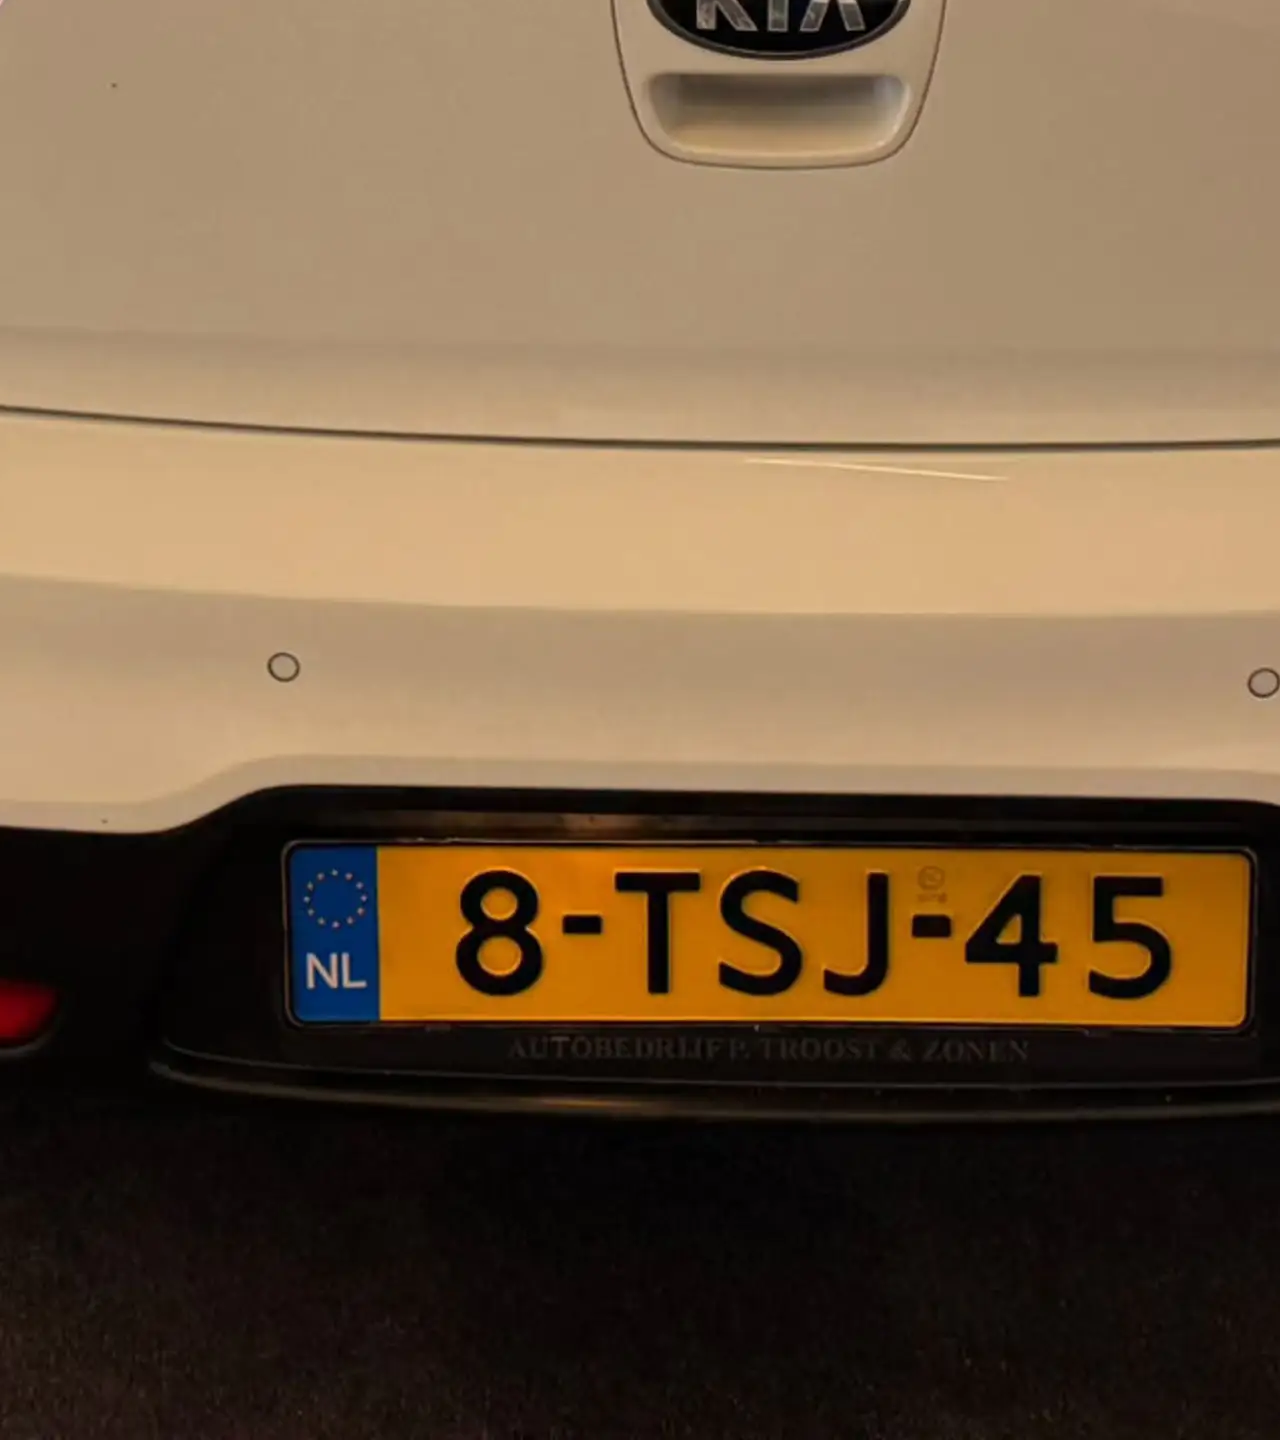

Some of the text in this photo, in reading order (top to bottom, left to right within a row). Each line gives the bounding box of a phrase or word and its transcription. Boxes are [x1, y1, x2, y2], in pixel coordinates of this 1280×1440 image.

[454, 866, 1174, 1000] 8-TSJ-45
[306, 952, 369, 990] NL
[507, 1036, 723, 1060] AUTOBEDRIJF
[758, 1037, 878, 1062] TROOST
